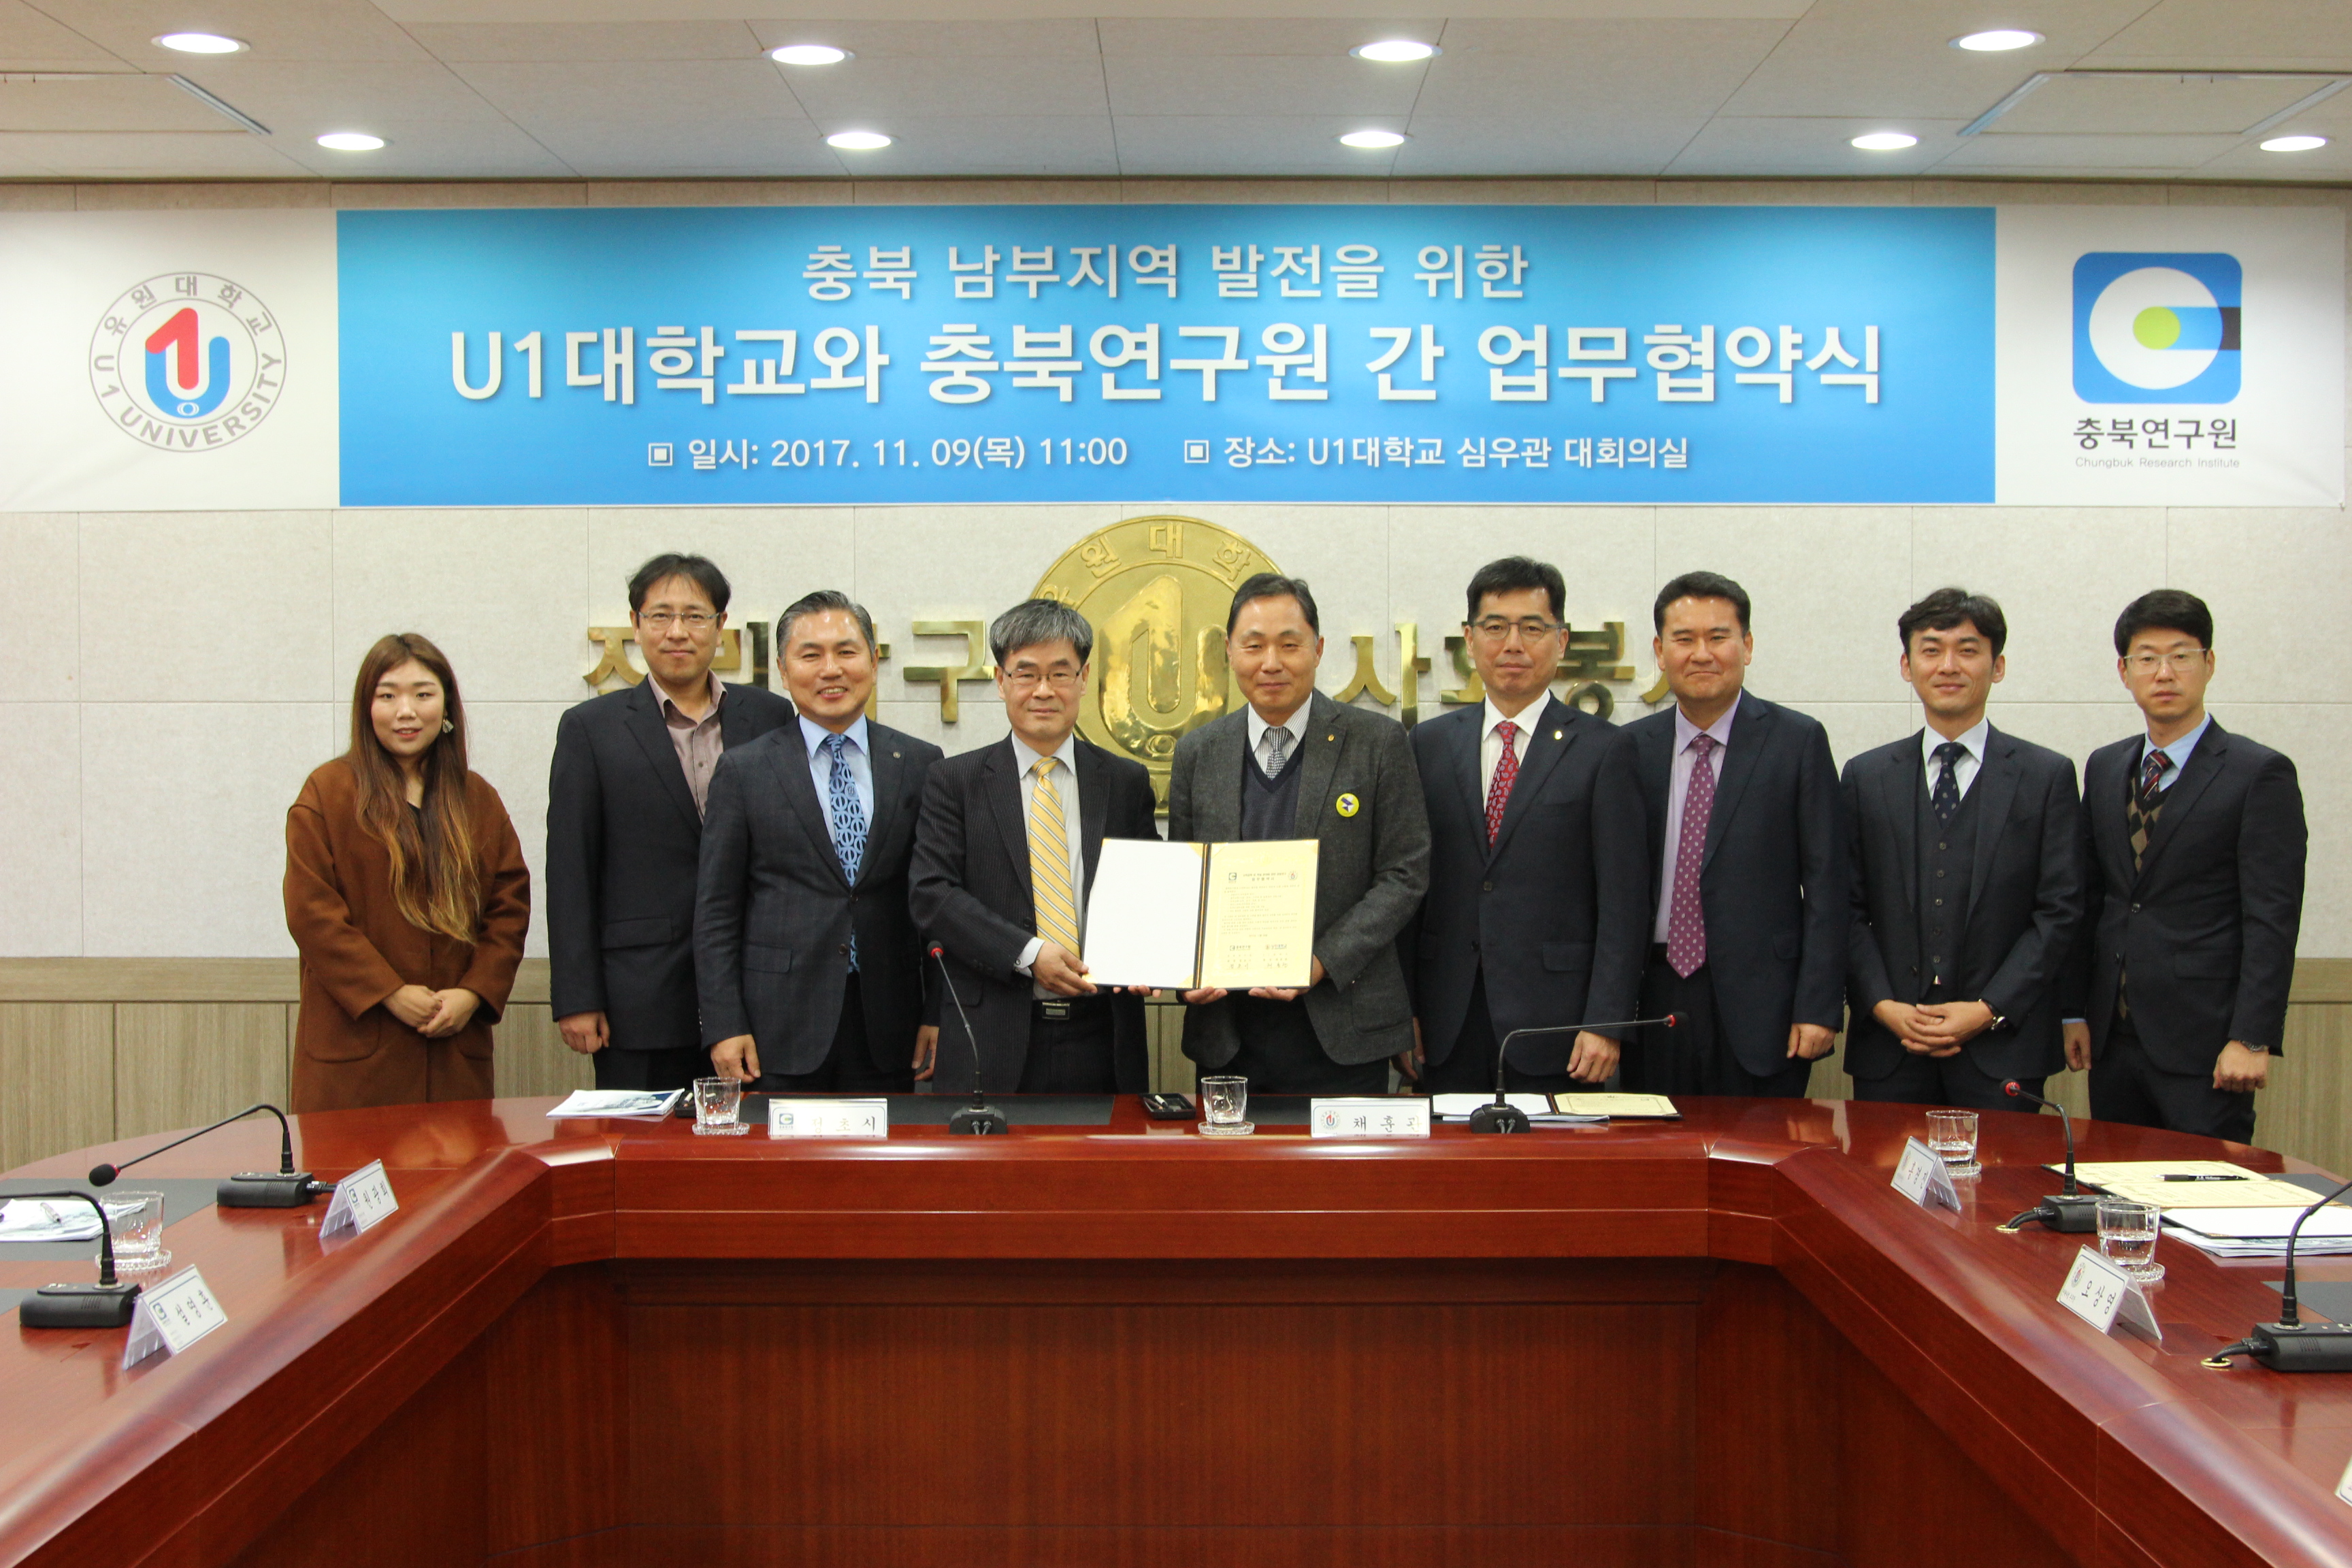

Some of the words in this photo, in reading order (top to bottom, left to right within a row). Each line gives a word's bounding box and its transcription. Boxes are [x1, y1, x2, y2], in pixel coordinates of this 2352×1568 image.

[803, 246, 917, 300] 충북
[949, 245, 1177, 299] 남부지역
[1212, 244, 1384, 299] 발전을
[1414, 245, 1529, 299] 위한
[104, 276, 272, 336] 유원대학교
[451, 325, 889, 404] U1대학교와
[920, 323, 1328, 404] 충북연구원
[1365, 323, 1445, 400] 간
[1477, 324, 1879, 404] 업무협약식
[120, 353, 282, 448] UNIVERSITY
[688, 439, 758, 470] 일시:
[771, 440, 859, 468] 2017.
[873, 439, 919, 467] 11.
[931, 436, 1026, 470] 09(목)
[1040, 438, 1127, 465] 11:00
[1224, 436, 1295, 468] 장소:
[1308, 436, 1446, 468] U1대학교
[1457, 437, 1552, 468] 심우관
[1565, 438, 1688, 468] 대회의실
[2074, 418, 2236, 450] 충북연구원
[2076, 457, 2134, 469] Chungbuk
[2140, 457, 2192, 468] Research
[2198, 457, 2240, 468] Institute
